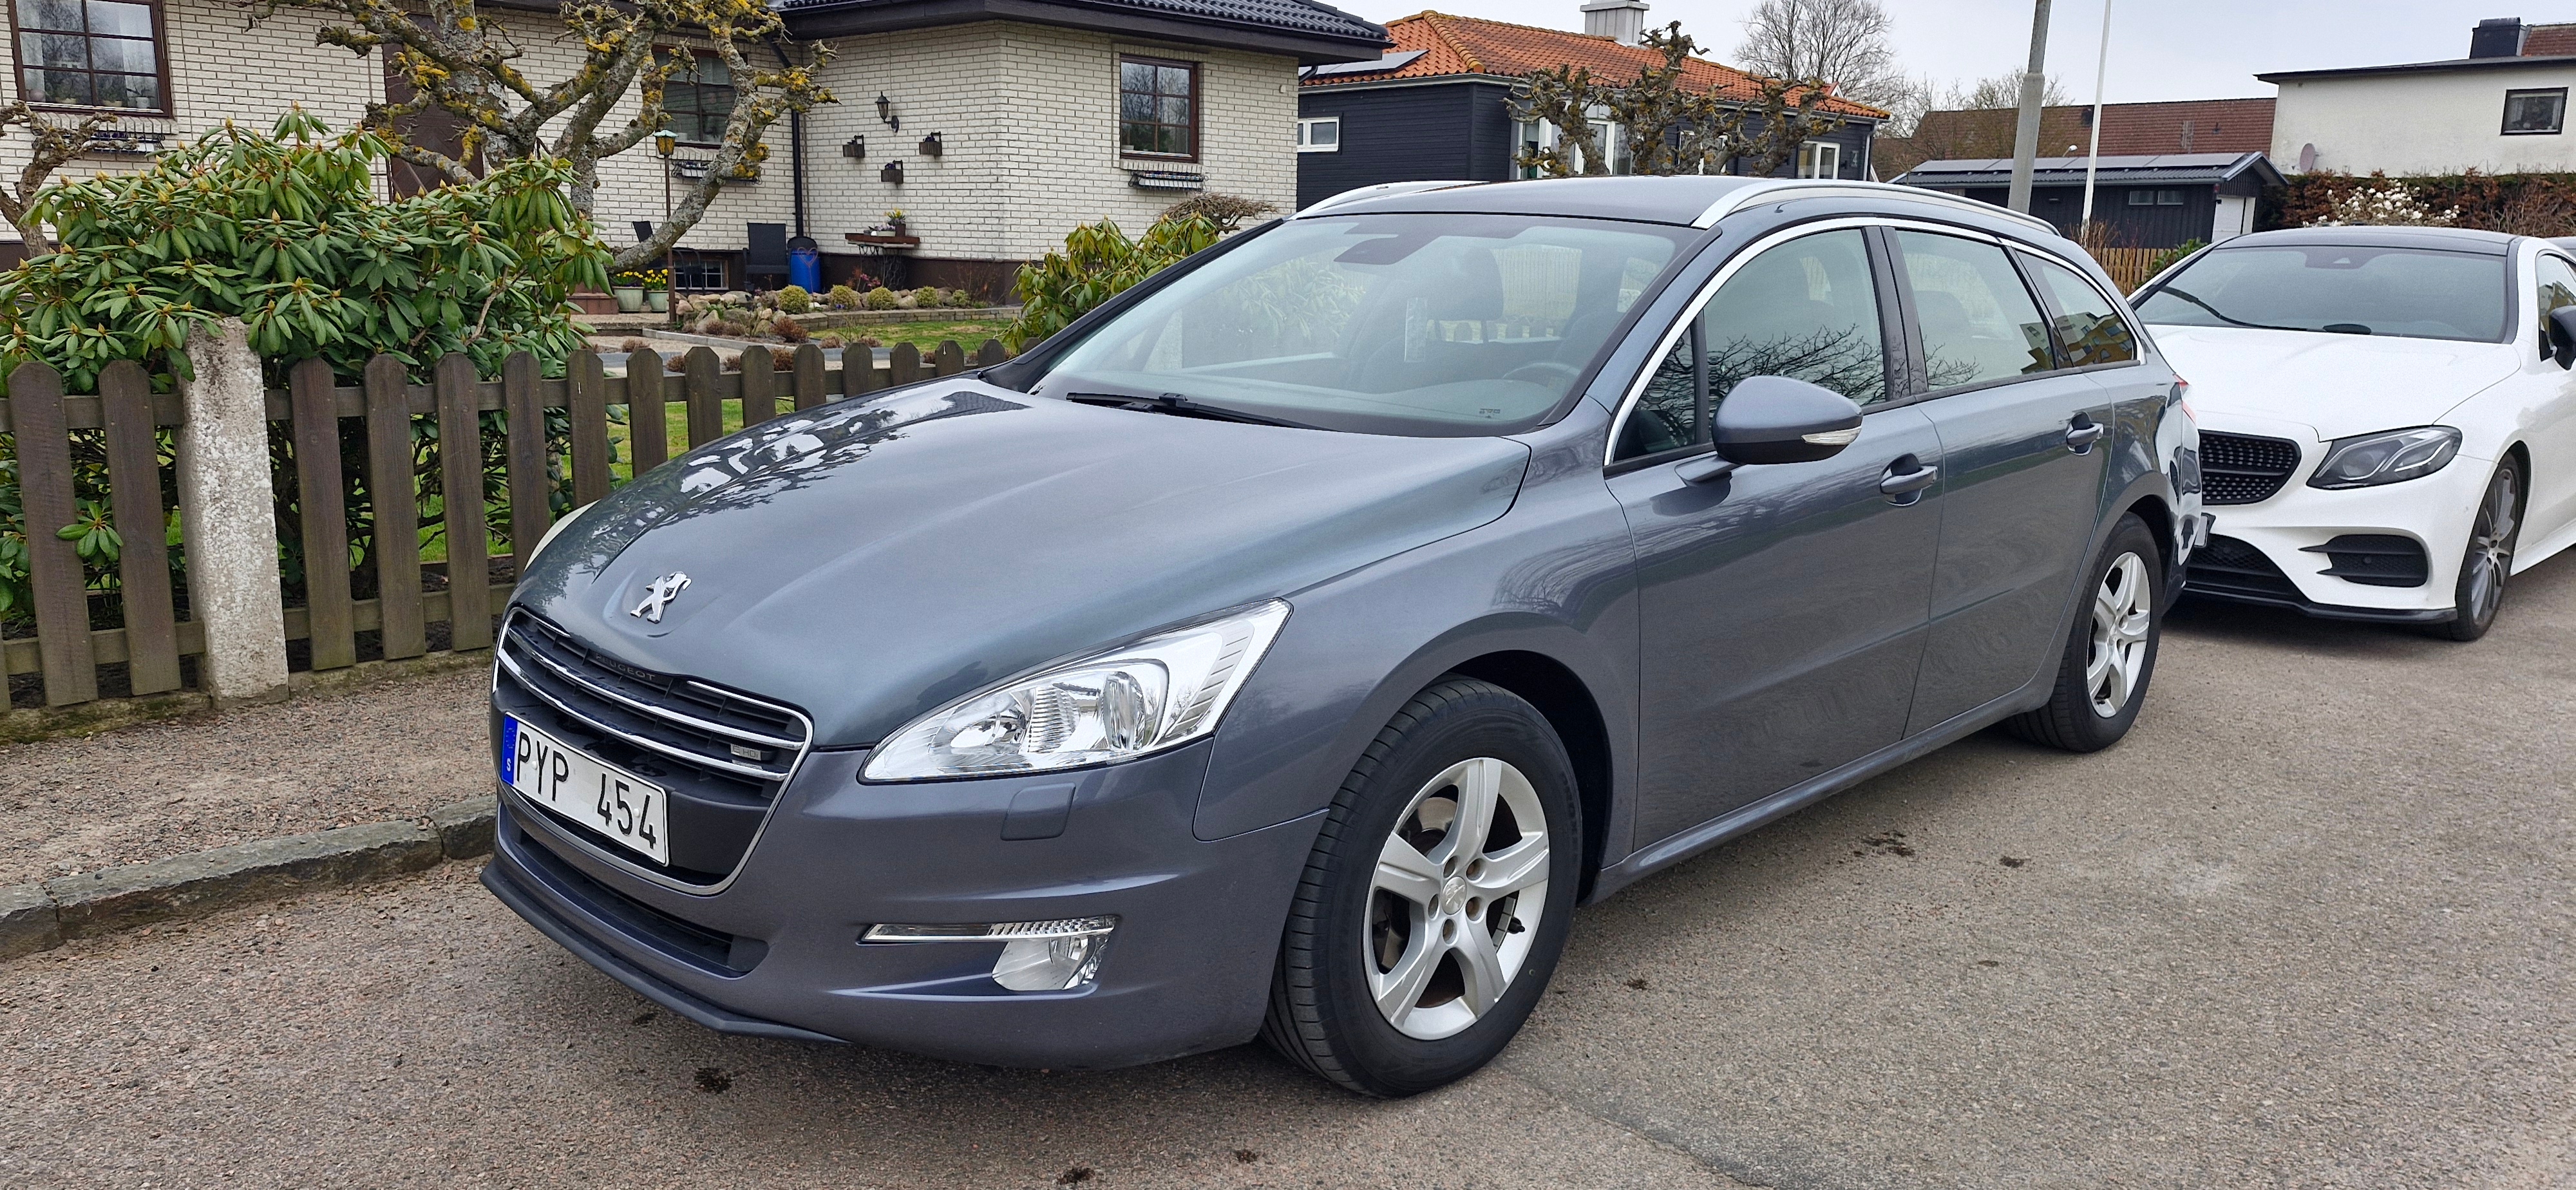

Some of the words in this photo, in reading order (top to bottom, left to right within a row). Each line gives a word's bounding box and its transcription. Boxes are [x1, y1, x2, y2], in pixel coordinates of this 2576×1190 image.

[596, 653, 656, 681] PEUGEOT
[507, 757, 511, 772] S
[516, 731, 569, 802] PYP
[597, 773, 656, 849] 454
